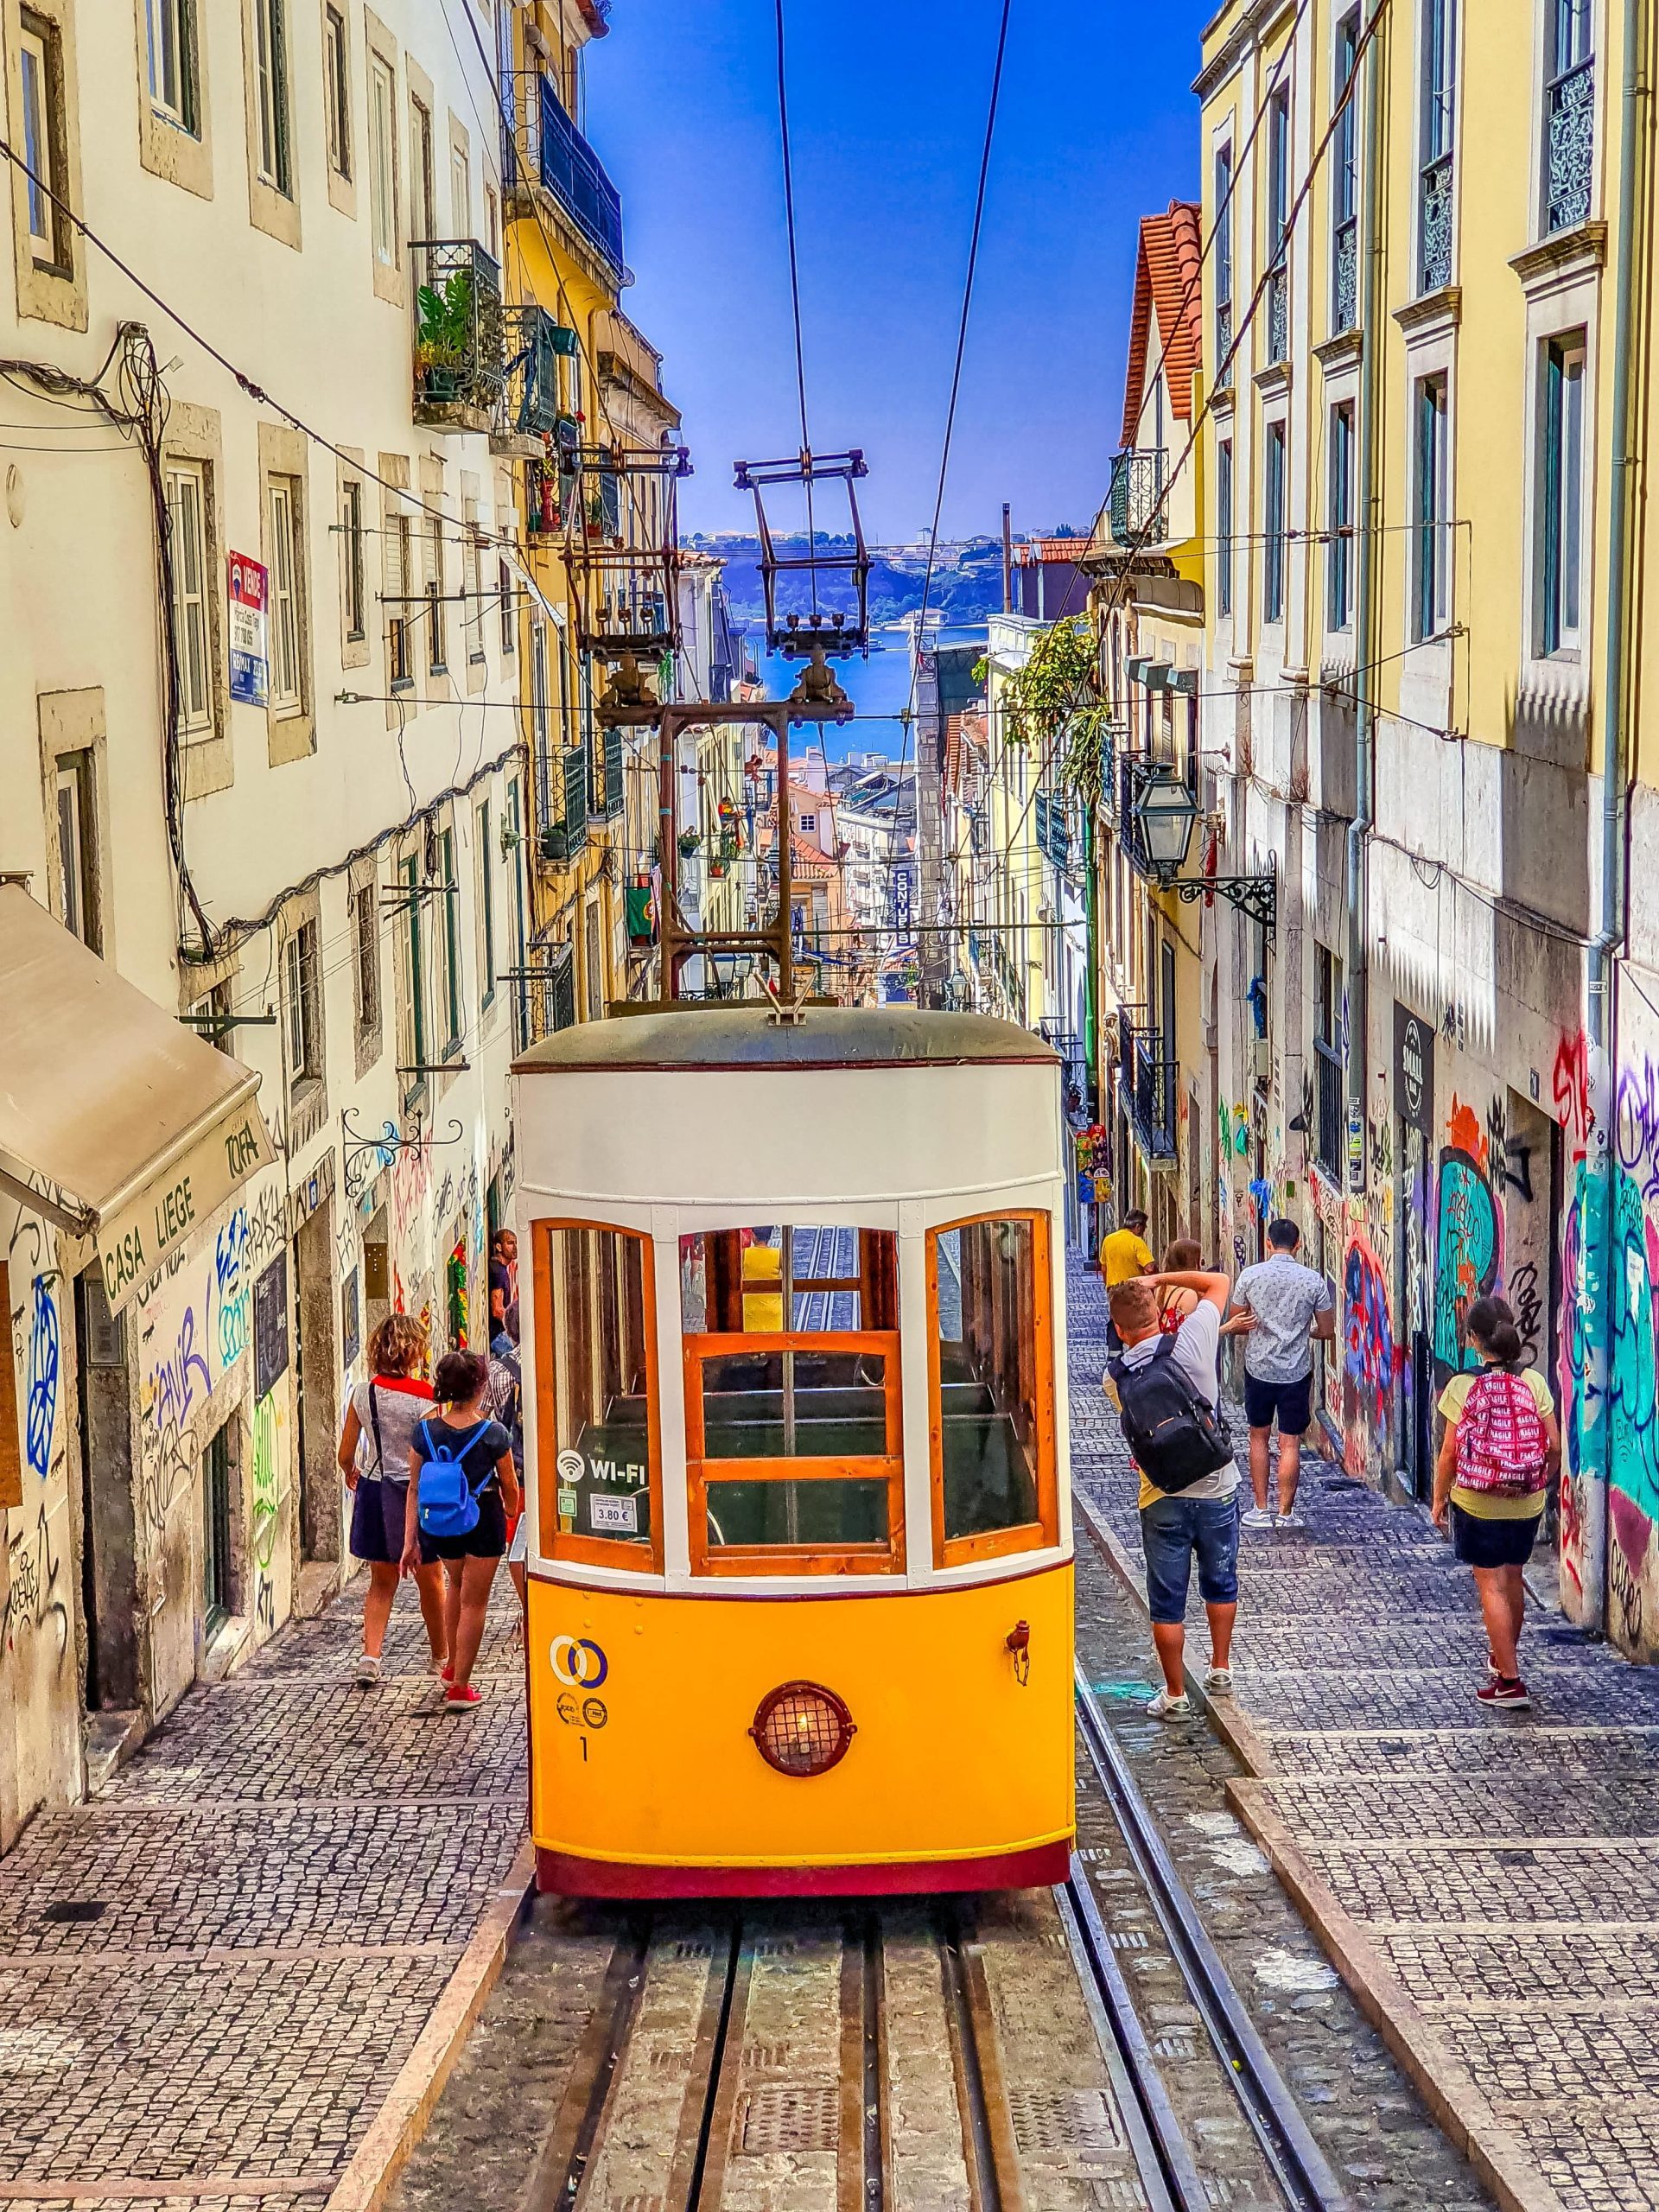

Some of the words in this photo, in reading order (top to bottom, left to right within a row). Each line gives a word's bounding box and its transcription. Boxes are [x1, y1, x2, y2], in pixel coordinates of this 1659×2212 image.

[243, 564, 261, 600] VENDE
[1402, 1044, 1424, 1086] SMALL
[105, 1224, 146, 1301] CASA
[155, 1175, 195, 1249] LIEGE
[224, 1119, 260, 1179] TOFA
[589, 1459, 645, 1485] WI-FI
[1498, 1471, 1525, 1481] FRAGILE
[598, 1509, 620, 1521] 3.80
[622, 1511, 629, 1522] €
[579, 1735, 588, 1762] 1
